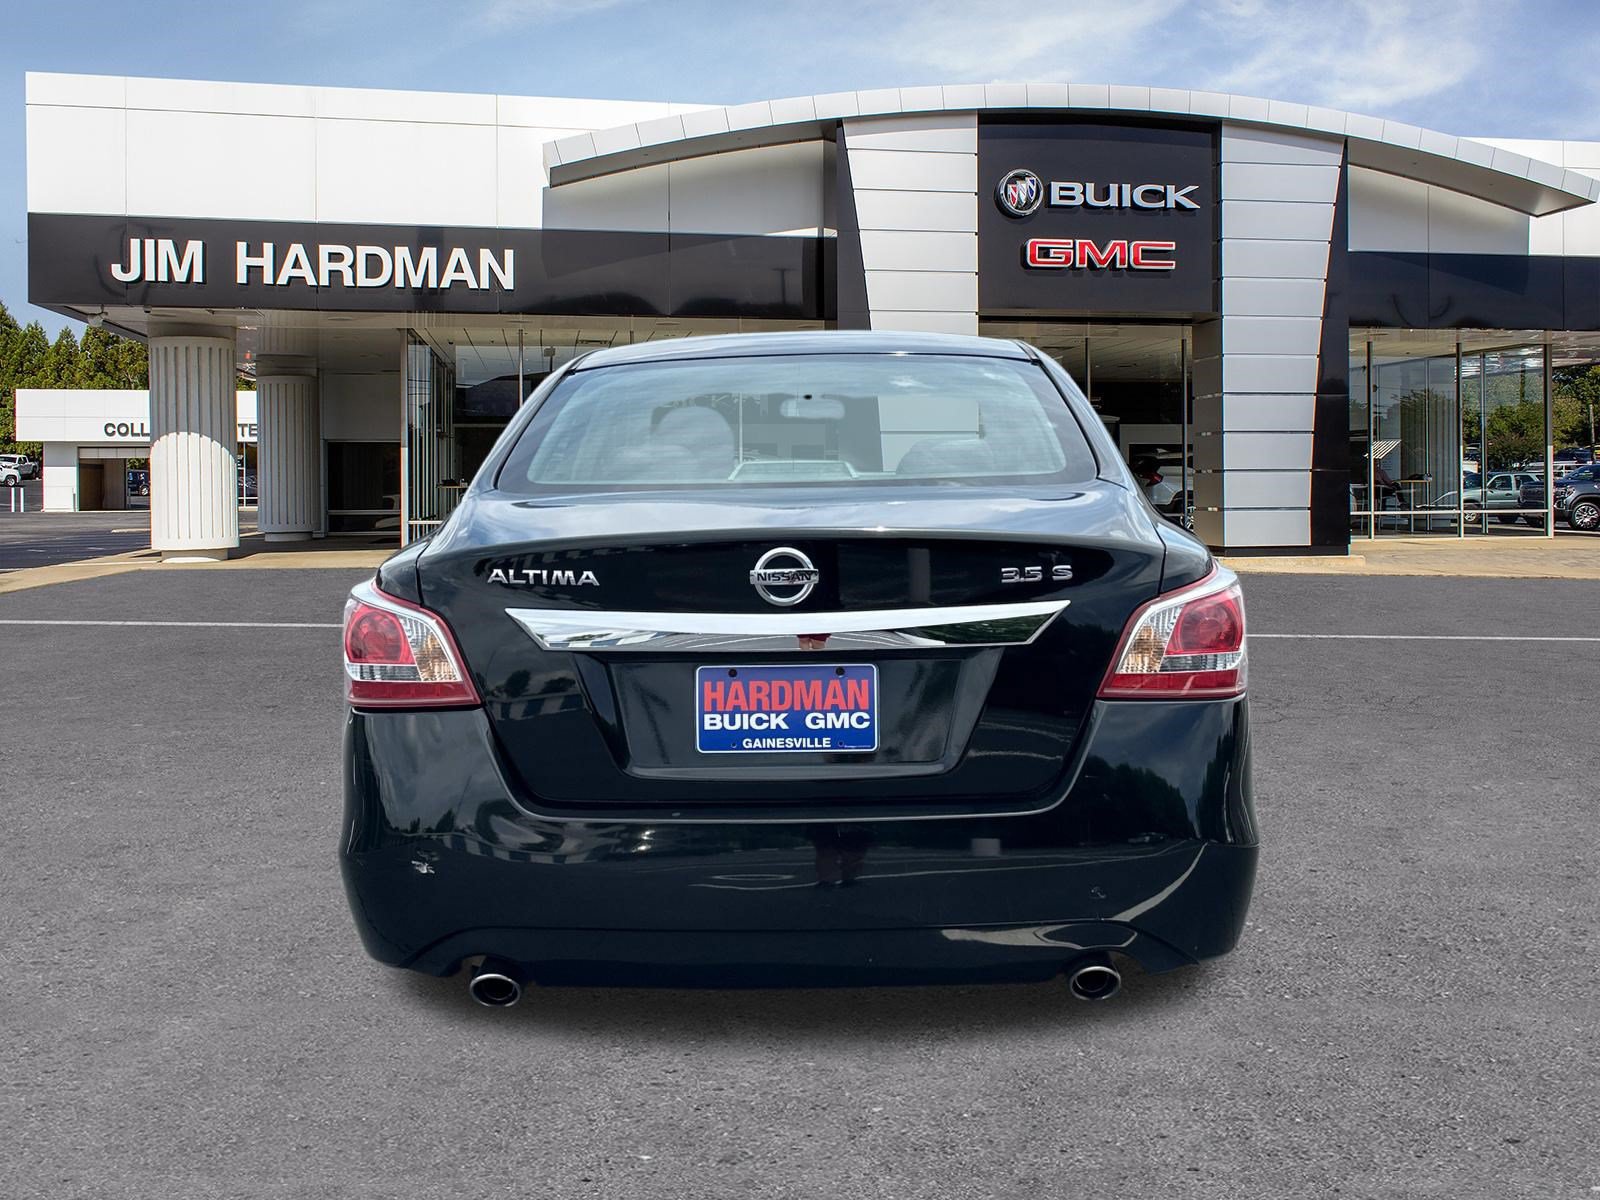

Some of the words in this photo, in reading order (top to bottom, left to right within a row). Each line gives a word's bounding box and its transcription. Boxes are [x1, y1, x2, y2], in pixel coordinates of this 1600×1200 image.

[1050, 181, 1200, 209] BUICK
[1025, 238, 1176, 270] GMC
[111, 238, 205, 284] JIM
[236, 241, 515, 291] HARDMAN
[487, 568, 600, 586] ALTIMA
[756, 571, 812, 583] NISSAN
[1000, 566, 1043, 583] 3.5
[1051, 564, 1074, 581] S
[703, 679, 869, 712] HARDMAN
[703, 712, 789, 731] BUICK
[805, 711, 871, 730] GMC
[742, 737, 832, 749] GAINESVILLE
